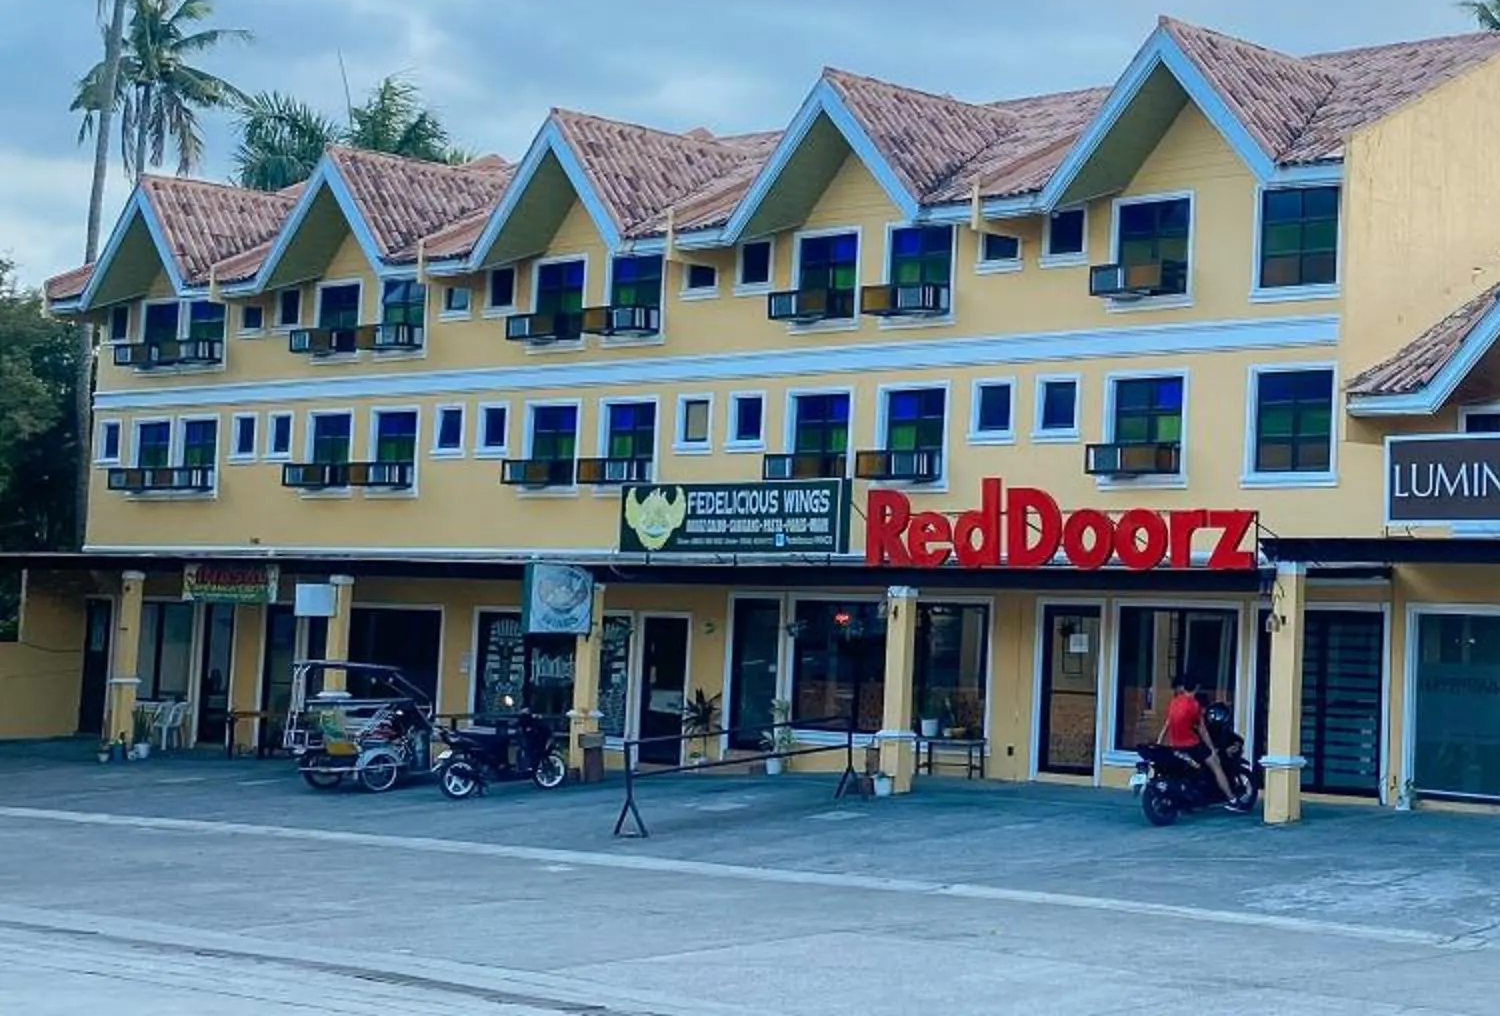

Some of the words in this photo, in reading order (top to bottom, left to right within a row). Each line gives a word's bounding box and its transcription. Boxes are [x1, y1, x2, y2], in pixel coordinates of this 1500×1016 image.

[687, 489, 779, 515] FEDELICIOUS
[783, 489, 830, 513] WINGS
[866, 477, 1254, 571] RedDoorz
